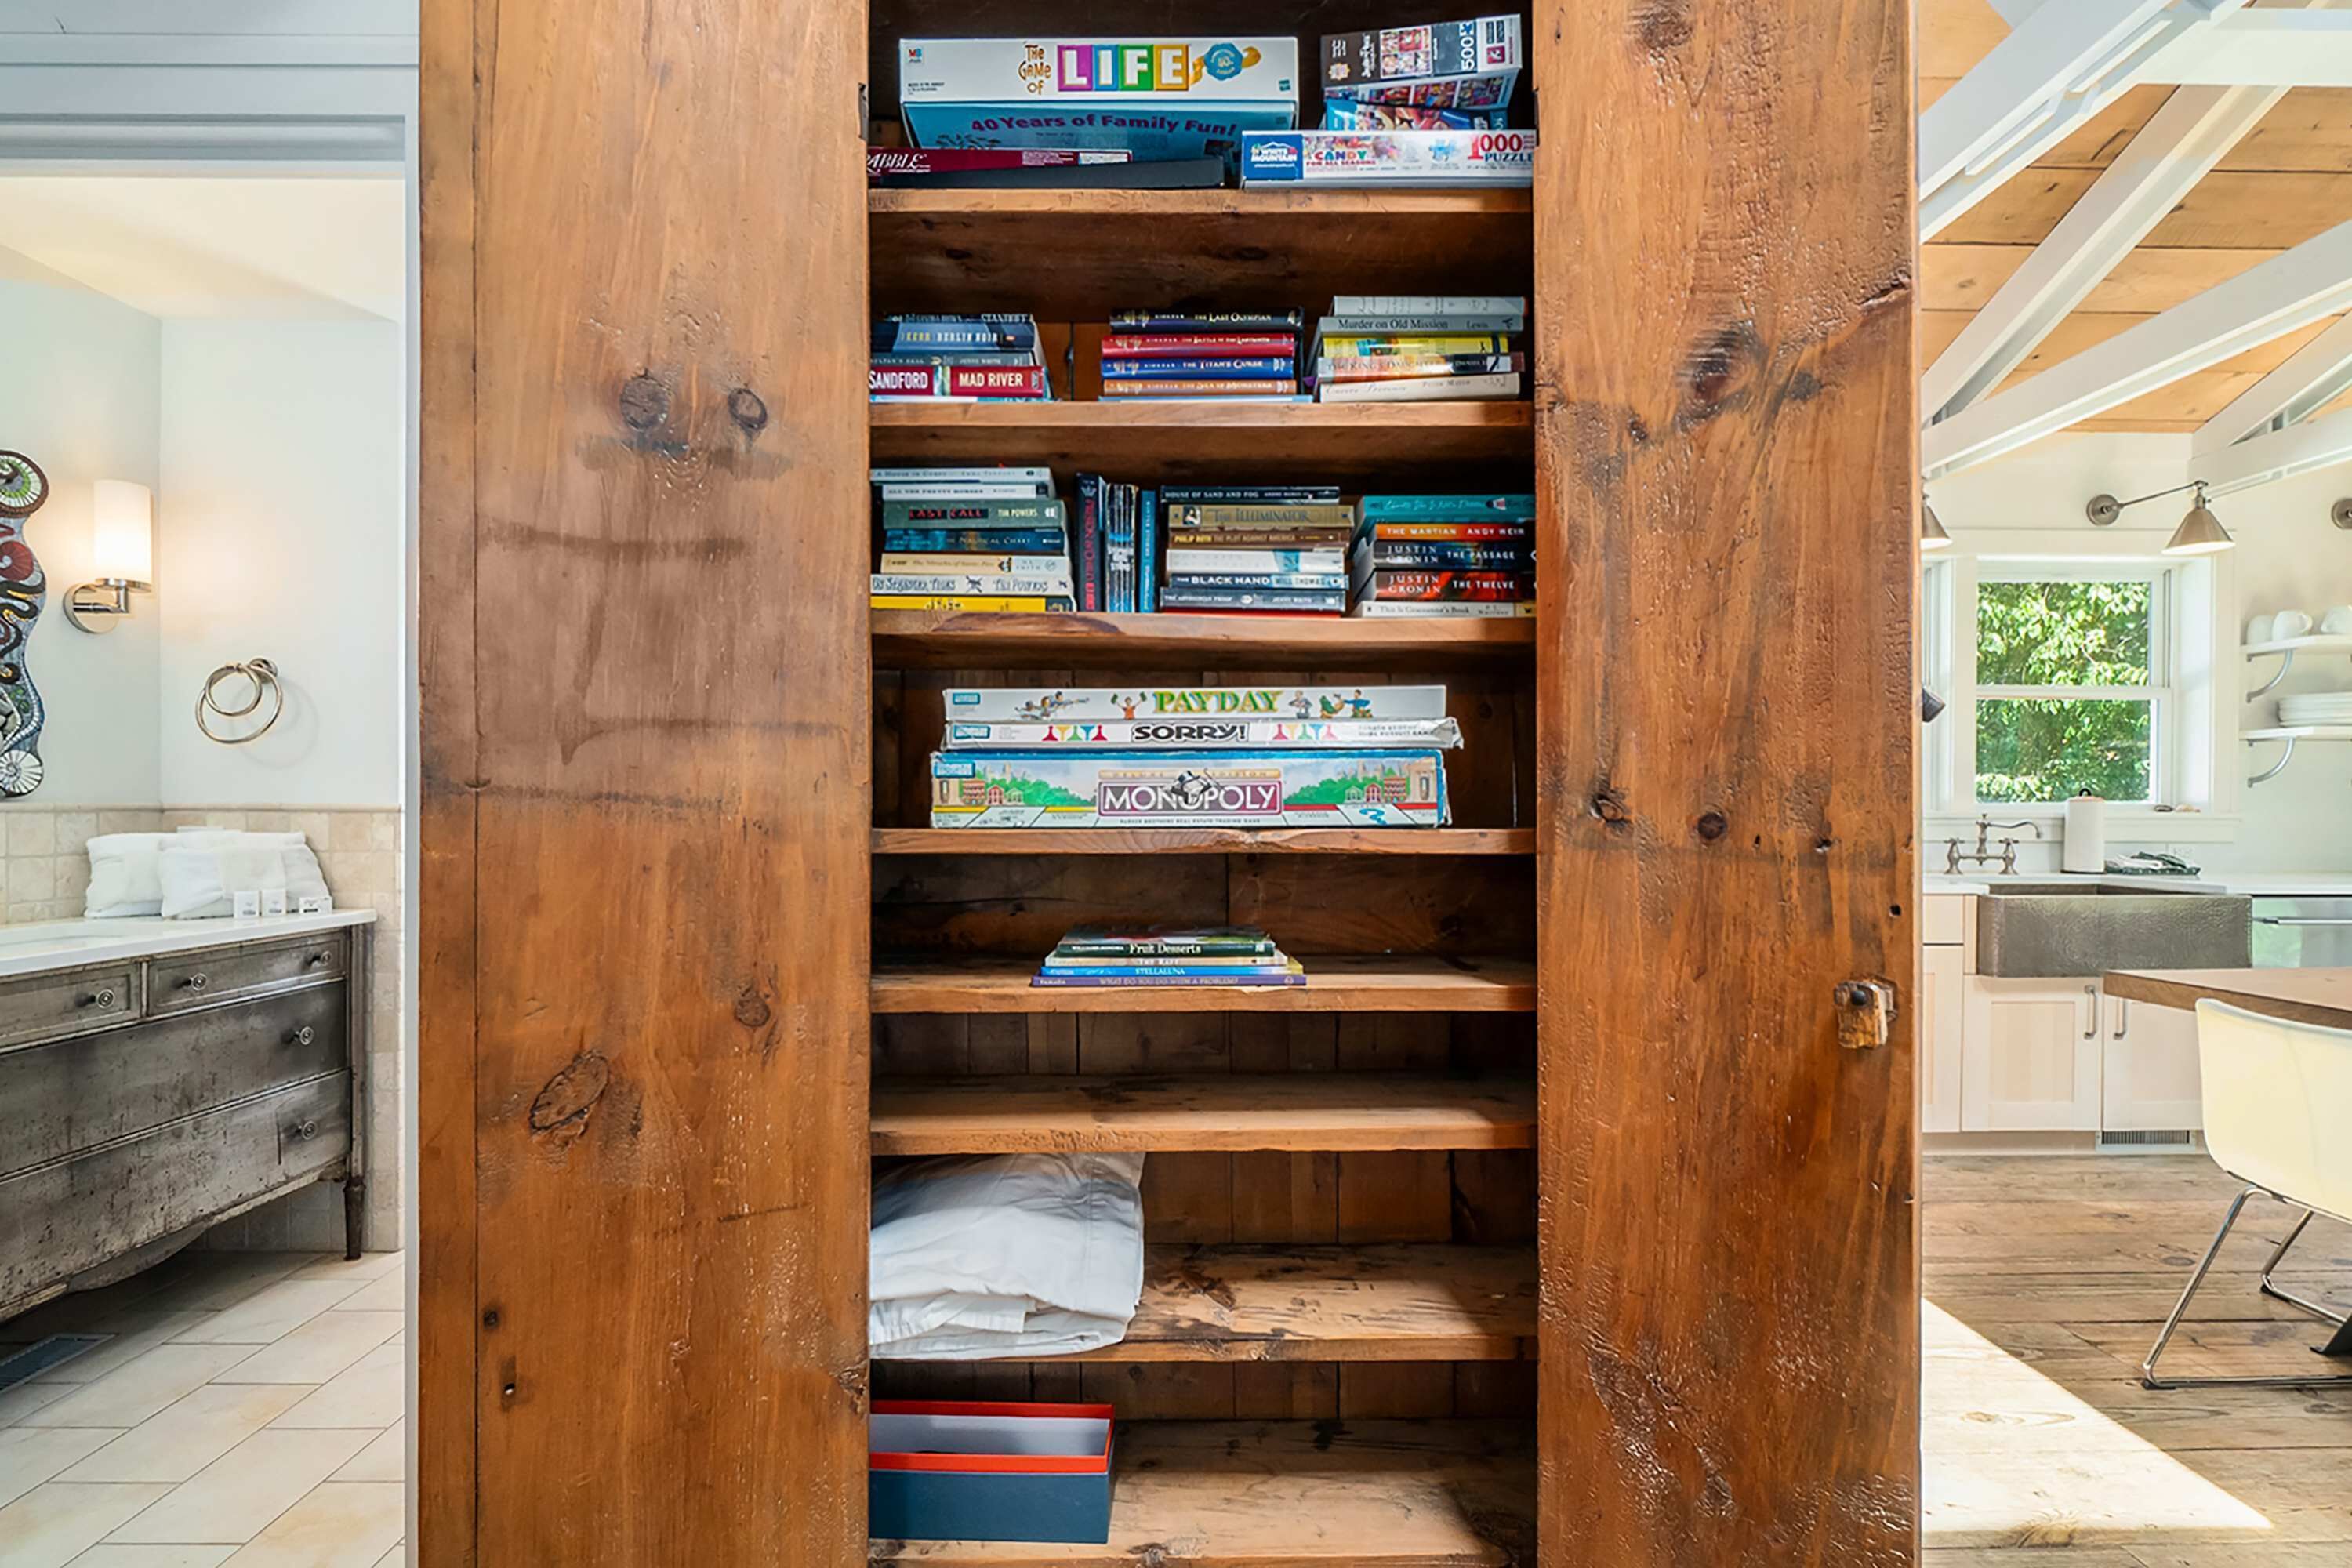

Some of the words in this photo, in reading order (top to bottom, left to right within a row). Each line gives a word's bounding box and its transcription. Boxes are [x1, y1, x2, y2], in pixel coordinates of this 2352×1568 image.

[1459, 36, 1475, 71] 500
[1062, 48, 1185, 88] LIFE
[971, 119, 1000, 132] 40
[1000, 115, 1065, 129] Years
[1072, 114, 1094, 126] of
[1102, 114, 1178, 134] Family
[1185, 120, 1237, 136] Fun!
[1468, 132, 1523, 161] 1000
[867, 153, 925, 169] ABBLE
[1251, 154, 1297, 162] MOUNTAIN
[1313, 150, 1367, 161] CANDY
[1338, 318, 1374, 329] Murder
[1390, 318, 1408, 329] Old
[1410, 318, 1449, 329] Mission
[868, 370, 929, 390] SANDFORD
[958, 372, 985, 387] MAD
[988, 372, 1024, 387] RIVER
[1203, 491, 1224, 499] SAND
[1225, 491, 1242, 499] AND
[1243, 491, 1259, 499] FOG
[1387, 545, 1437, 554] JUSTIN
[1447, 550, 1465, 559] THE
[1470, 550, 1515, 560] PASSAGE
[1385, 555, 1439, 564] CRONIN
[1191, 576, 1233, 585] BLACK
[1234, 576, 1270, 585] HAND
[1388, 575, 1439, 584] JUSTIN
[1452, 580, 1471, 589] THE
[1476, 580, 1515, 590] TWELVE
[1388, 586, 1442, 594] CRONIN
[1152, 690, 1285, 714] PAYDAY
[1134, 725, 1247, 740] SORRY!
[1104, 785, 1276, 811] MONOPOLY
[1129, 943, 1155, 954] Fruit
[1157, 943, 1202, 954] Desserts
